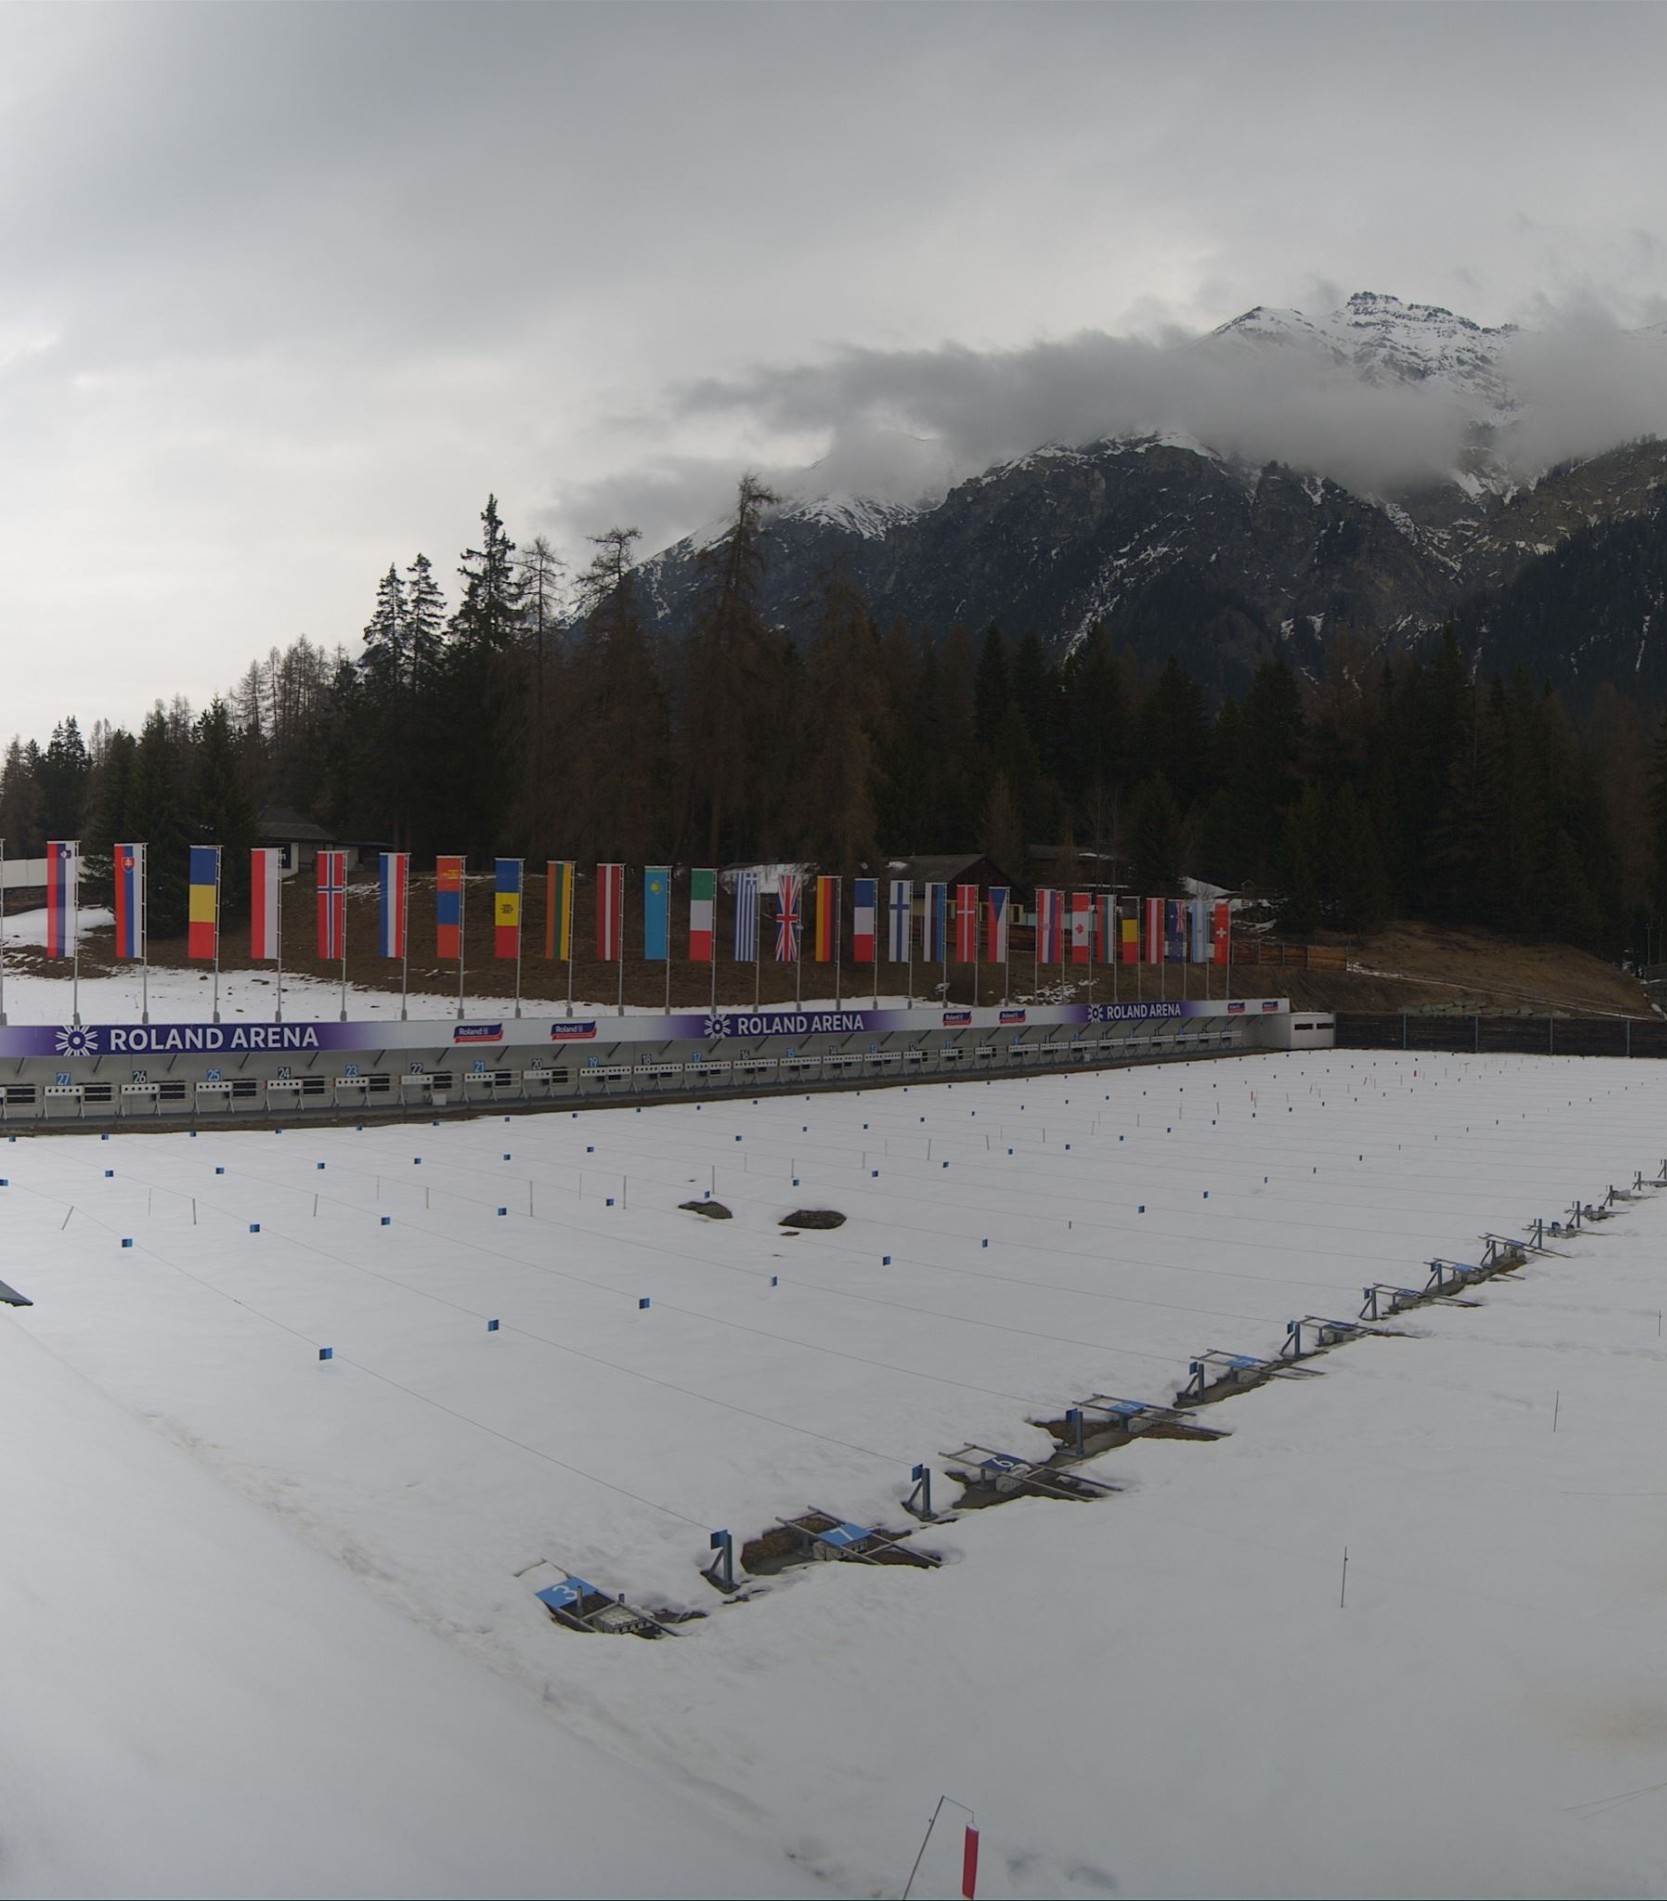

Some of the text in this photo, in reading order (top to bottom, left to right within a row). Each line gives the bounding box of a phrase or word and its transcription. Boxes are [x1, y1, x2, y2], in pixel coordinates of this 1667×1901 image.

[1106, 1003, 1182, 1020] ROLAND ARENA
[737, 1014, 864, 1035] ROLAND ARENA
[458, 1026, 484, 1036] Roland
[109, 1026, 320, 1051] ROLAND ARENA
[474, 1061, 484, 1072] 21
[531, 1058, 542, 1069] 20
[588, 1056, 598, 1067] 19
[207, 1069, 220, 1081] 25
[278, 1067, 291, 1079] 24
[345, 1065, 358, 1077] 23
[411, 1063, 423, 1075] 22
[57, 1072, 70, 1085] 27
[133, 1070, 147, 1084] 26
